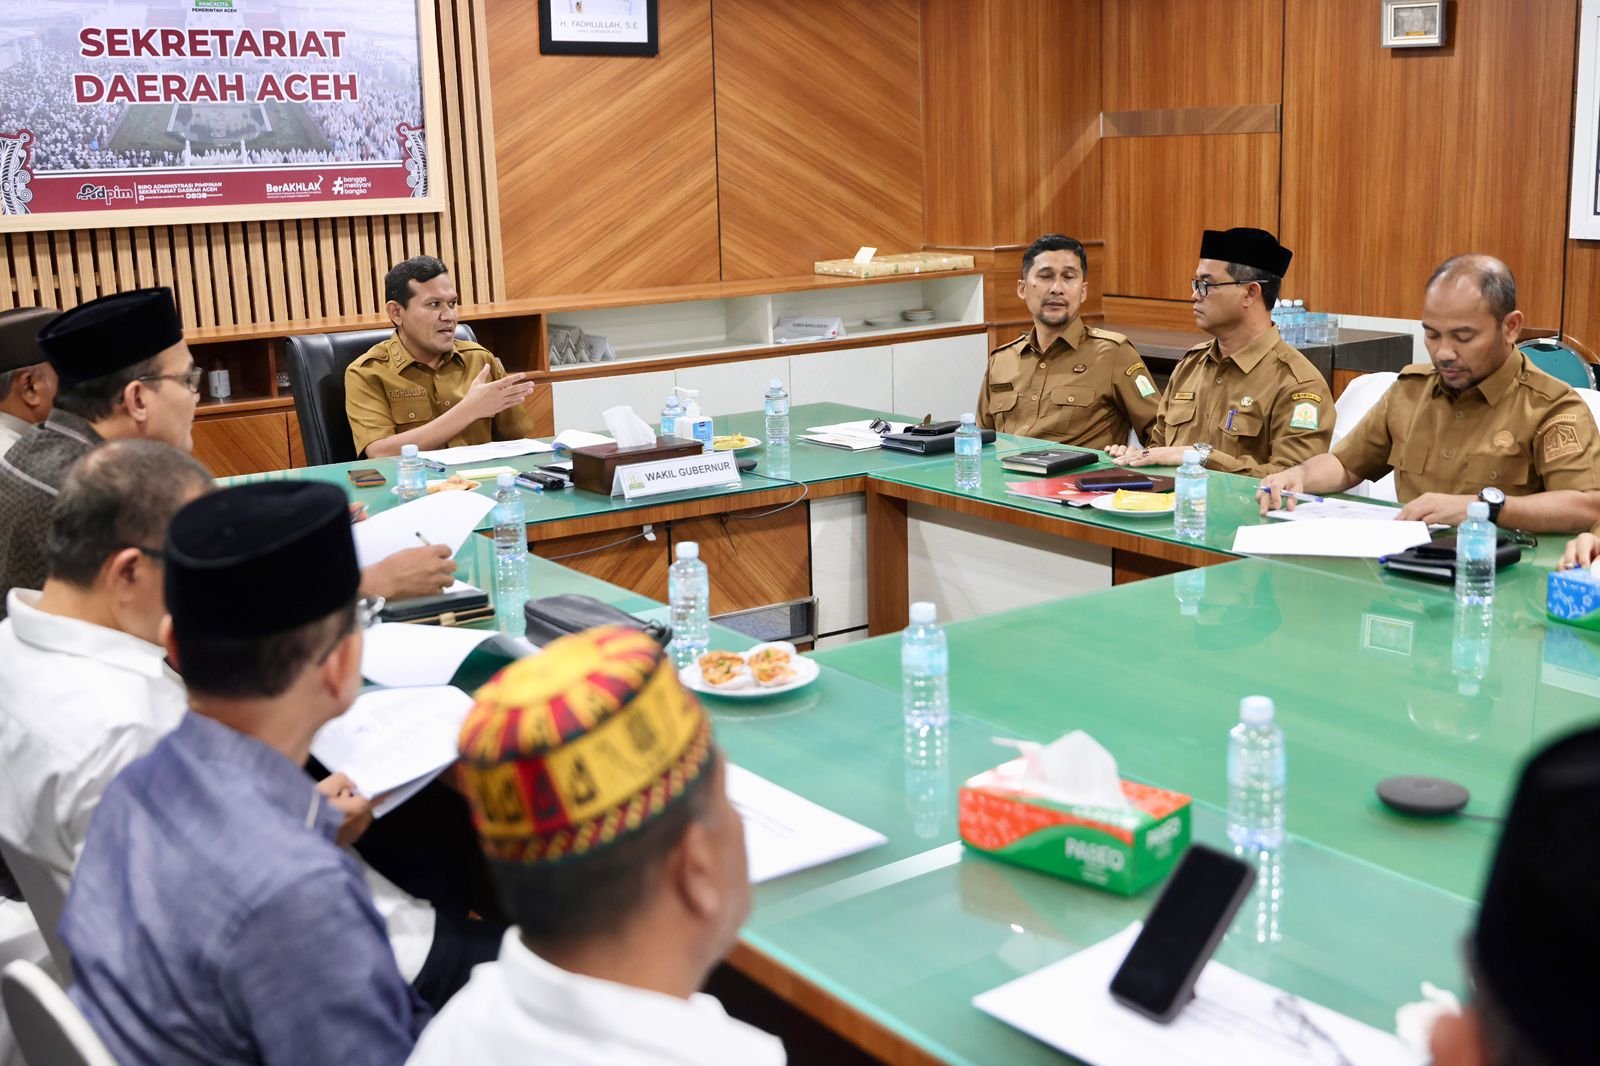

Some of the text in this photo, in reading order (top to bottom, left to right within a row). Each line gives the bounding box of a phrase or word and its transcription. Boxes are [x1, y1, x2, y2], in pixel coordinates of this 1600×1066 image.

[79, 27, 347, 58] SEKRETARIAT
[74, 73, 359, 103] DAERAH ACEH
[265, 180, 322, 193] BerAKHLAK
[343, 176, 367, 184] bangga
[645, 461, 732, 482] WAKIL GUBERNUR
